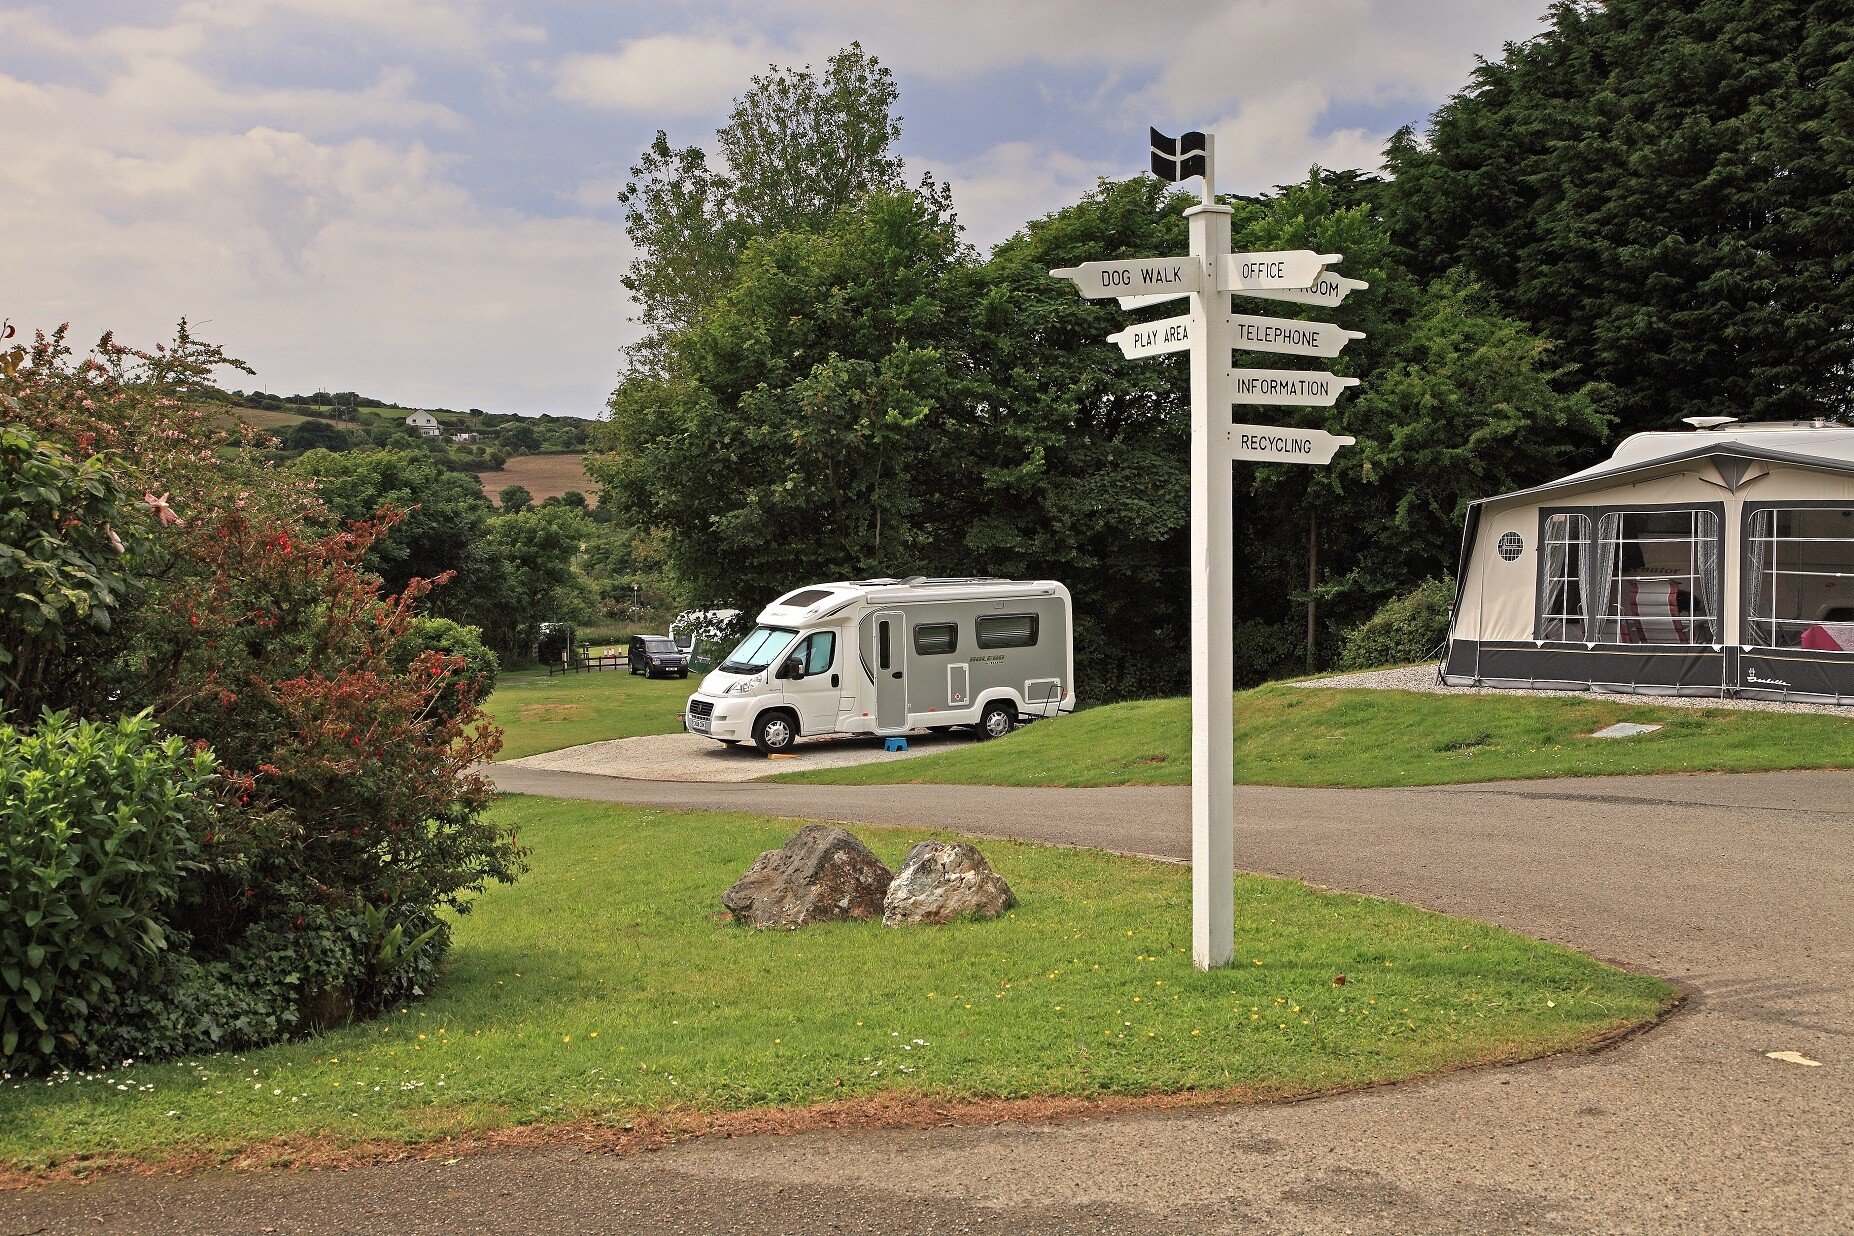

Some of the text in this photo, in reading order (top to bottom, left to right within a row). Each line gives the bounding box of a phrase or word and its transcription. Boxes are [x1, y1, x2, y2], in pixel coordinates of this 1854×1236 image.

[1101, 266, 1182, 287] DOG WALK
[1242, 261, 1285, 279] OFFICE
[1133, 324, 1189, 349] PLAY AREA
[1237, 323, 1320, 348] TELEPHONE
[1236, 378, 1329, 396] INFORMATION
[1241, 434, 1312, 454] RECYCLING
